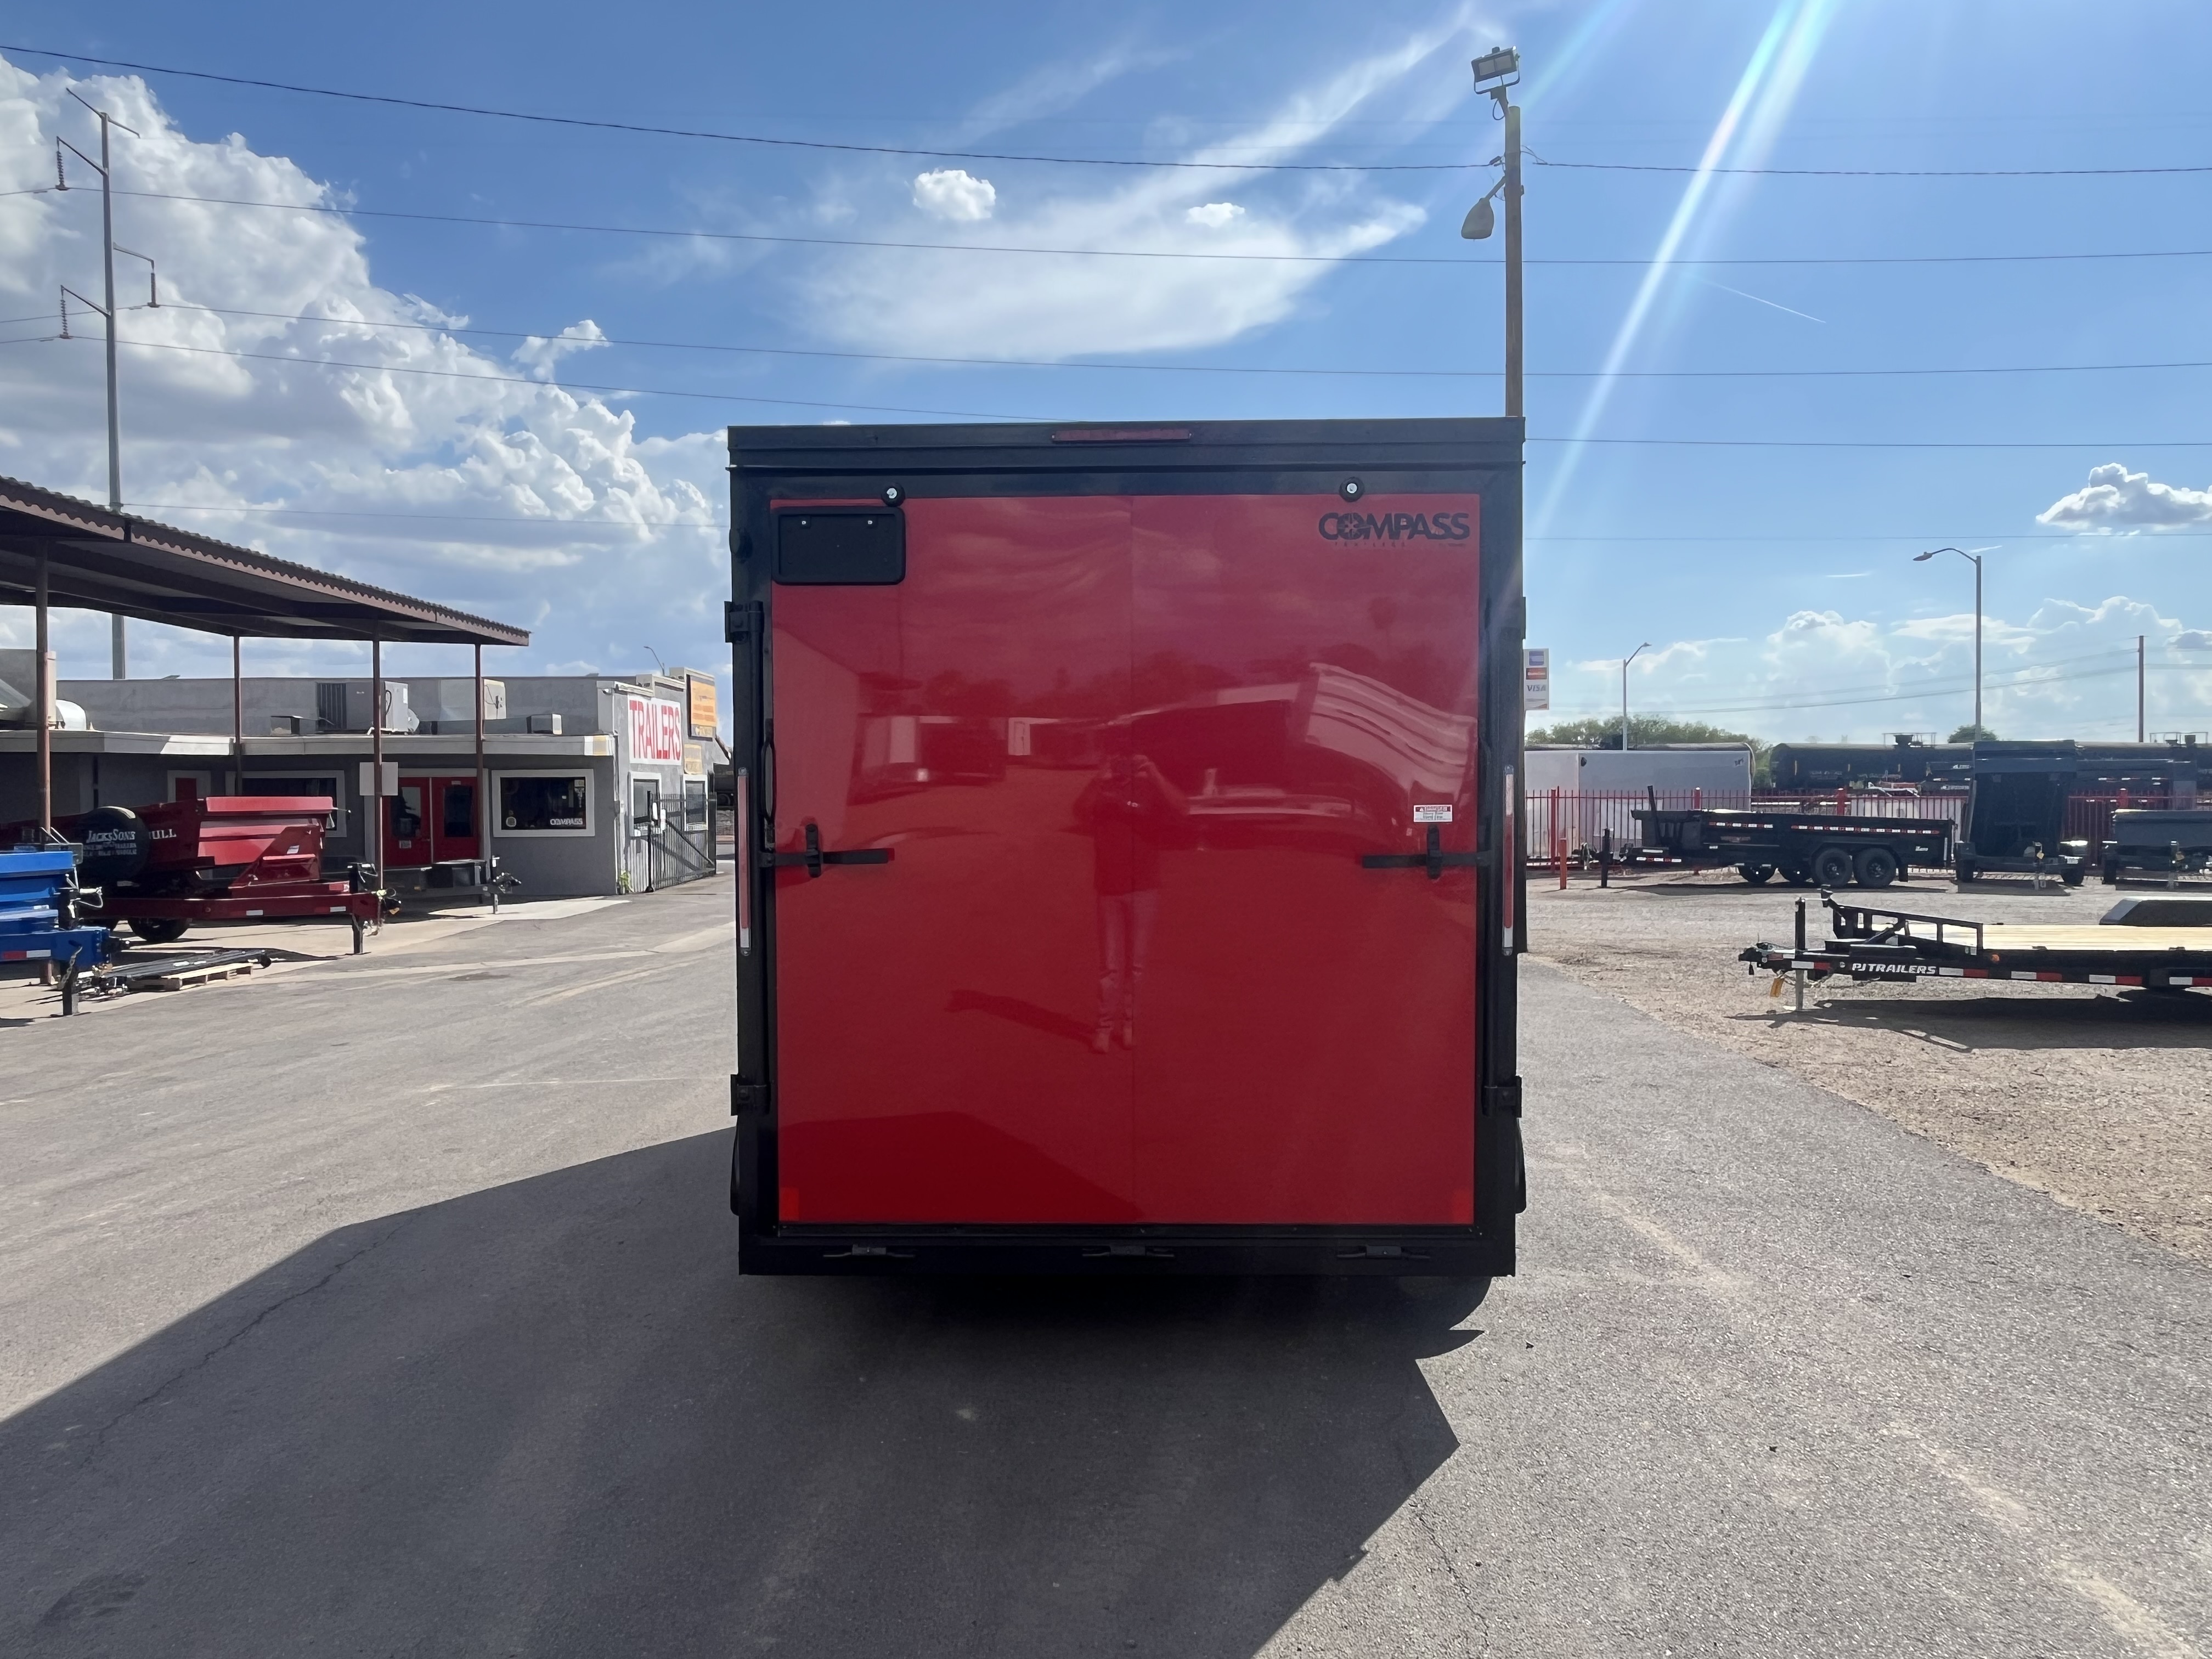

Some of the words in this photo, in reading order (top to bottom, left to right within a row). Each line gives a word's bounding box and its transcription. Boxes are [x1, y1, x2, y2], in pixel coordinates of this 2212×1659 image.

[1319, 512, 1470, 540] COMPASS
[629, 700, 680, 761] TRAILERS
[149, 828, 177, 839] ULL
[1852, 963, 1866, 972] PJ
[1868, 963, 1937, 974] TRAILERS
